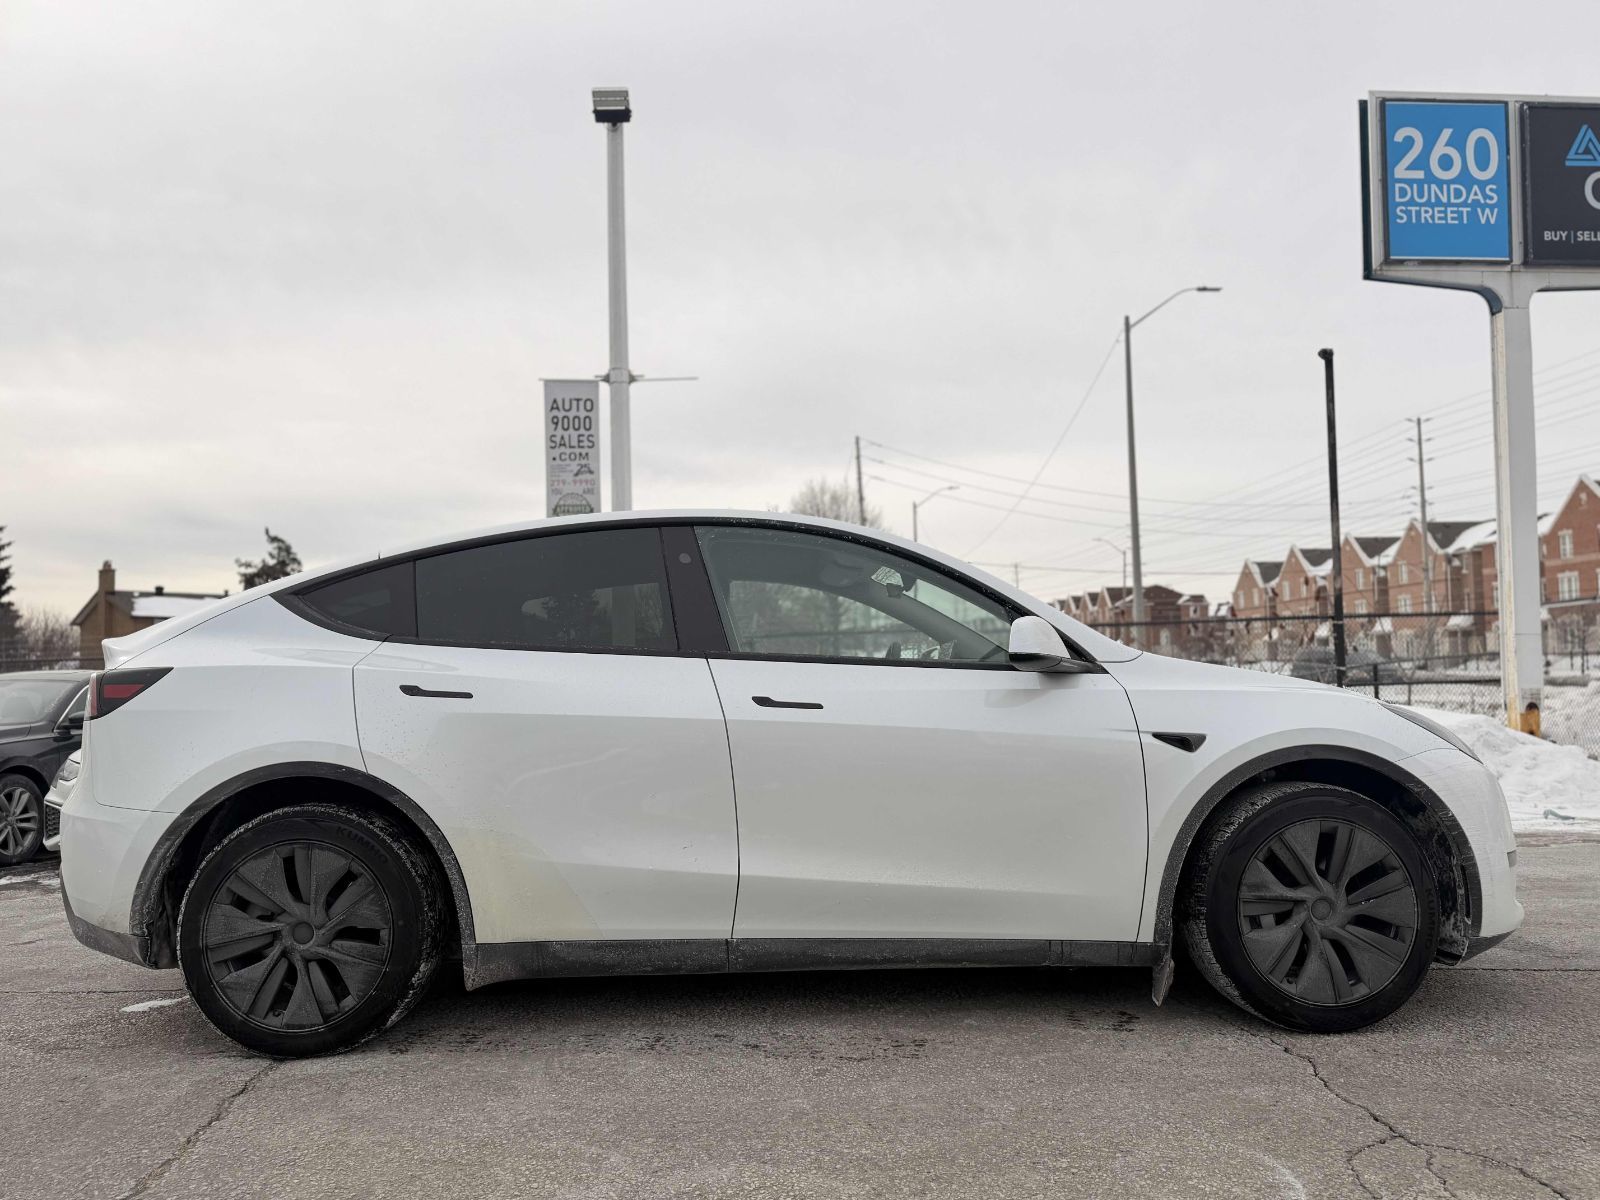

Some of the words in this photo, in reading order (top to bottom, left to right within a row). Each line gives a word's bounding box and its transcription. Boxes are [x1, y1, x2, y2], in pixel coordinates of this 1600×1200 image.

[1393, 126, 1499, 181] 260
[1394, 183, 1498, 204] DUNDAS
[1395, 206, 1471, 224] STREET
[1477, 208, 1498, 225] W
[1543, 230, 1568, 241] BUY
[549, 397, 594, 413] AUTO
[551, 415, 593, 432] 9000
[549, 433, 595, 449] SALES
[552, 451, 589, 462] .COM
[336, 826, 388, 864] KUMHO
[1424, 888, 1436, 950] KUMHO
